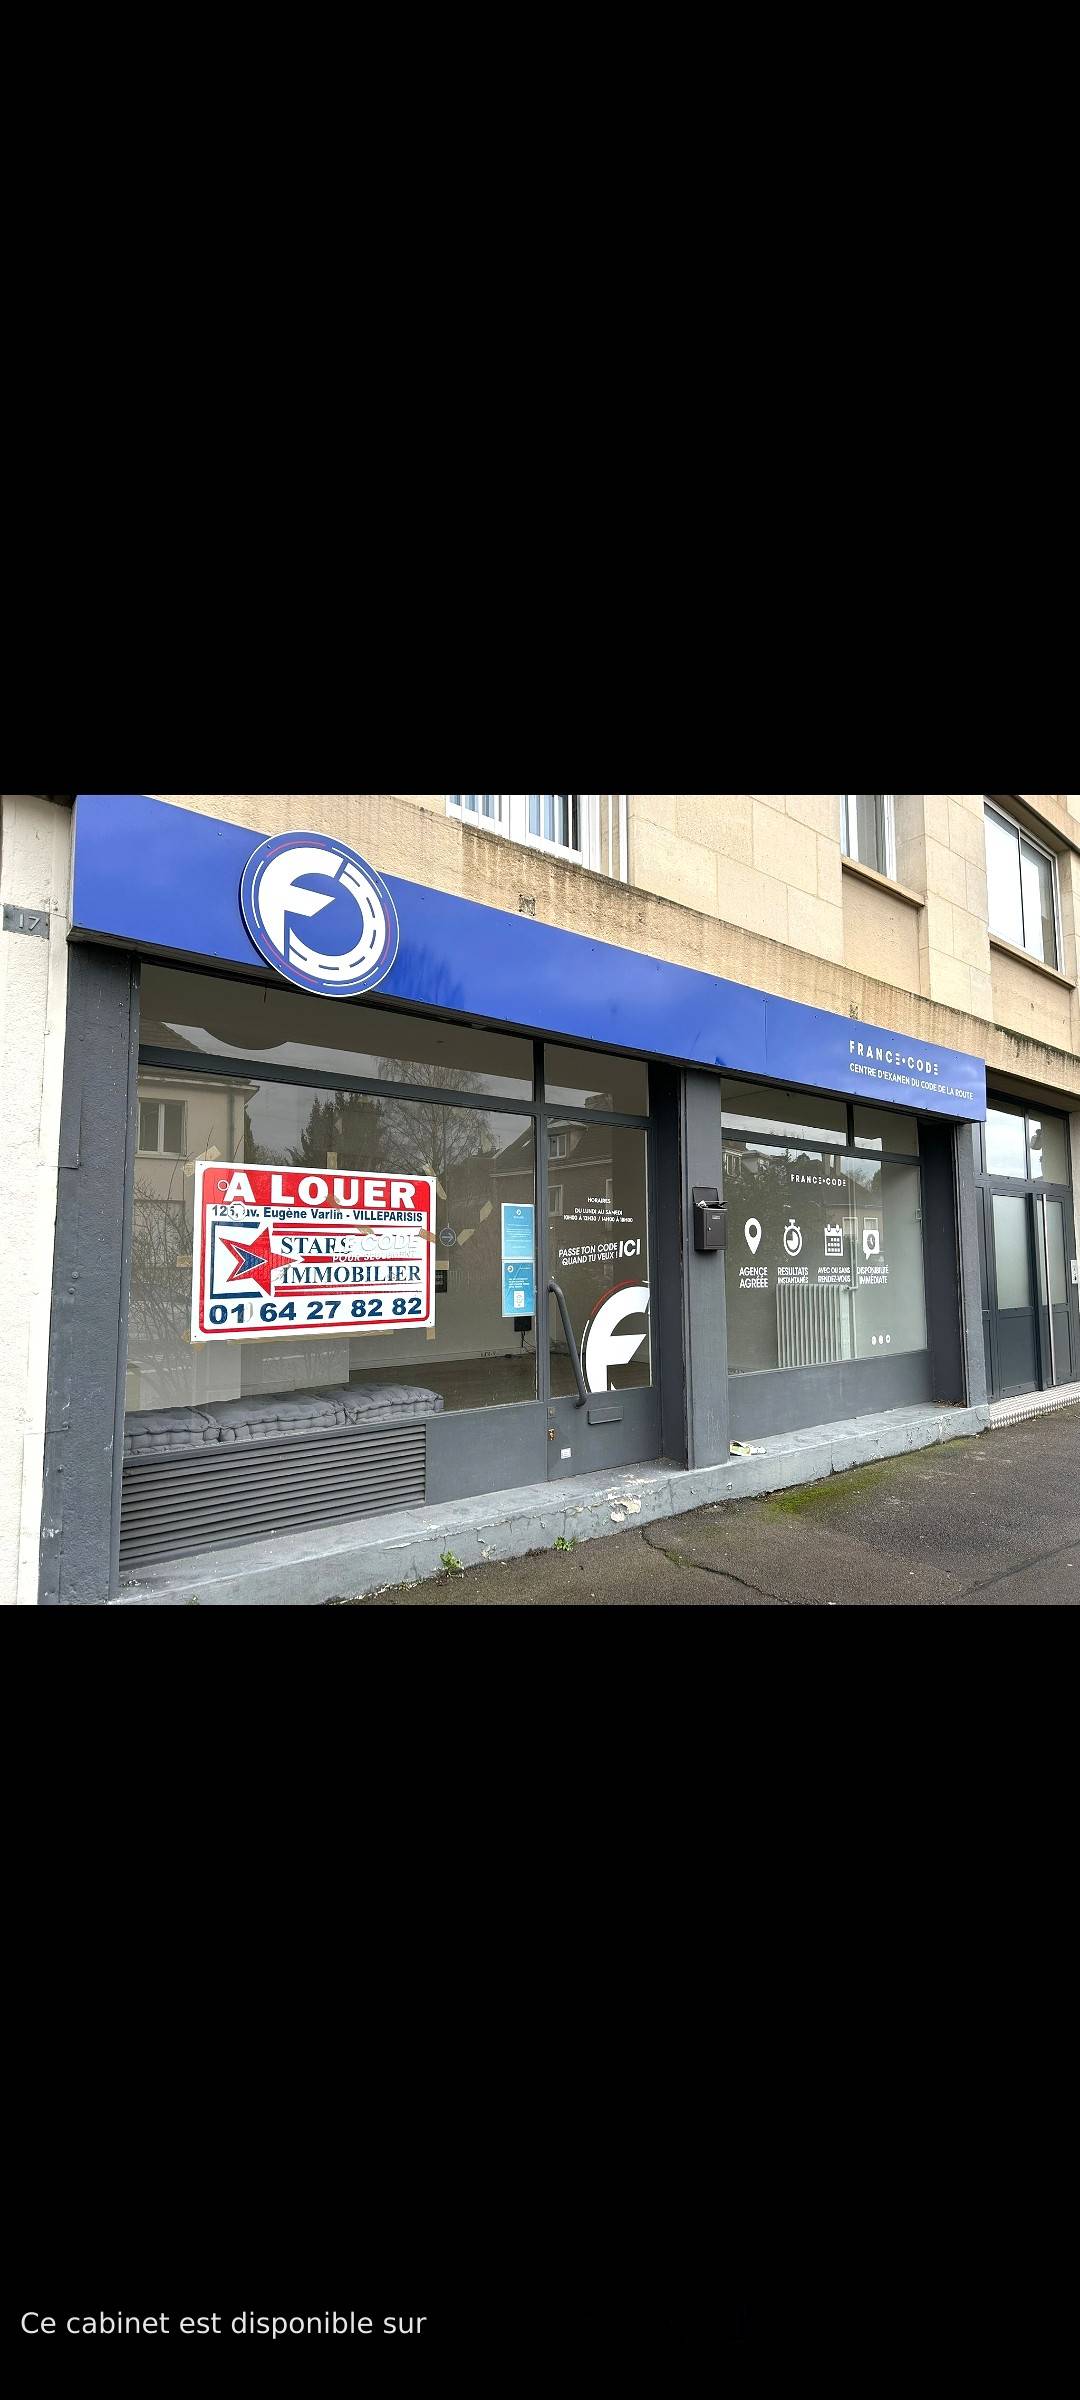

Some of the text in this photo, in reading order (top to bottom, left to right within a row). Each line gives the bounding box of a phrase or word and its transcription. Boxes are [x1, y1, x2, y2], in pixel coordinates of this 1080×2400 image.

[19, 913, 41, 931] 17
[849, 1062, 974, 1100] CENTRE D'EXAMEN DU CODE DE LA ROUTE
[223, 1172, 416, 1208] A LOUER
[264, 1207, 307, 1221] Eugène
[310, 1208, 344, 1220] Varlin
[353, 1209, 423, 1222] VILLEPARISIS
[559, 1242, 618, 1258] PASSE TON CODE
[619, 1239, 640, 1257] ICI
[562, 1255, 588, 1266] QUAND
[588, 1254, 596, 1262] TU
[597, 1251, 614, 1261] VEUX
[282, 1265, 421, 1284] IMMOBILIER
[739, 1266, 768, 1276] AGENCE
[817, 1266, 851, 1274] AVEC OU SANS
[739, 1276, 769, 1288] AGRÉÉE
[817, 1275, 851, 1284] RENDEZ-VOUS
[859, 1274, 888, 1285] IMMÉDIATE
[209, 1297, 422, 1325] 01 64 27 82 82
